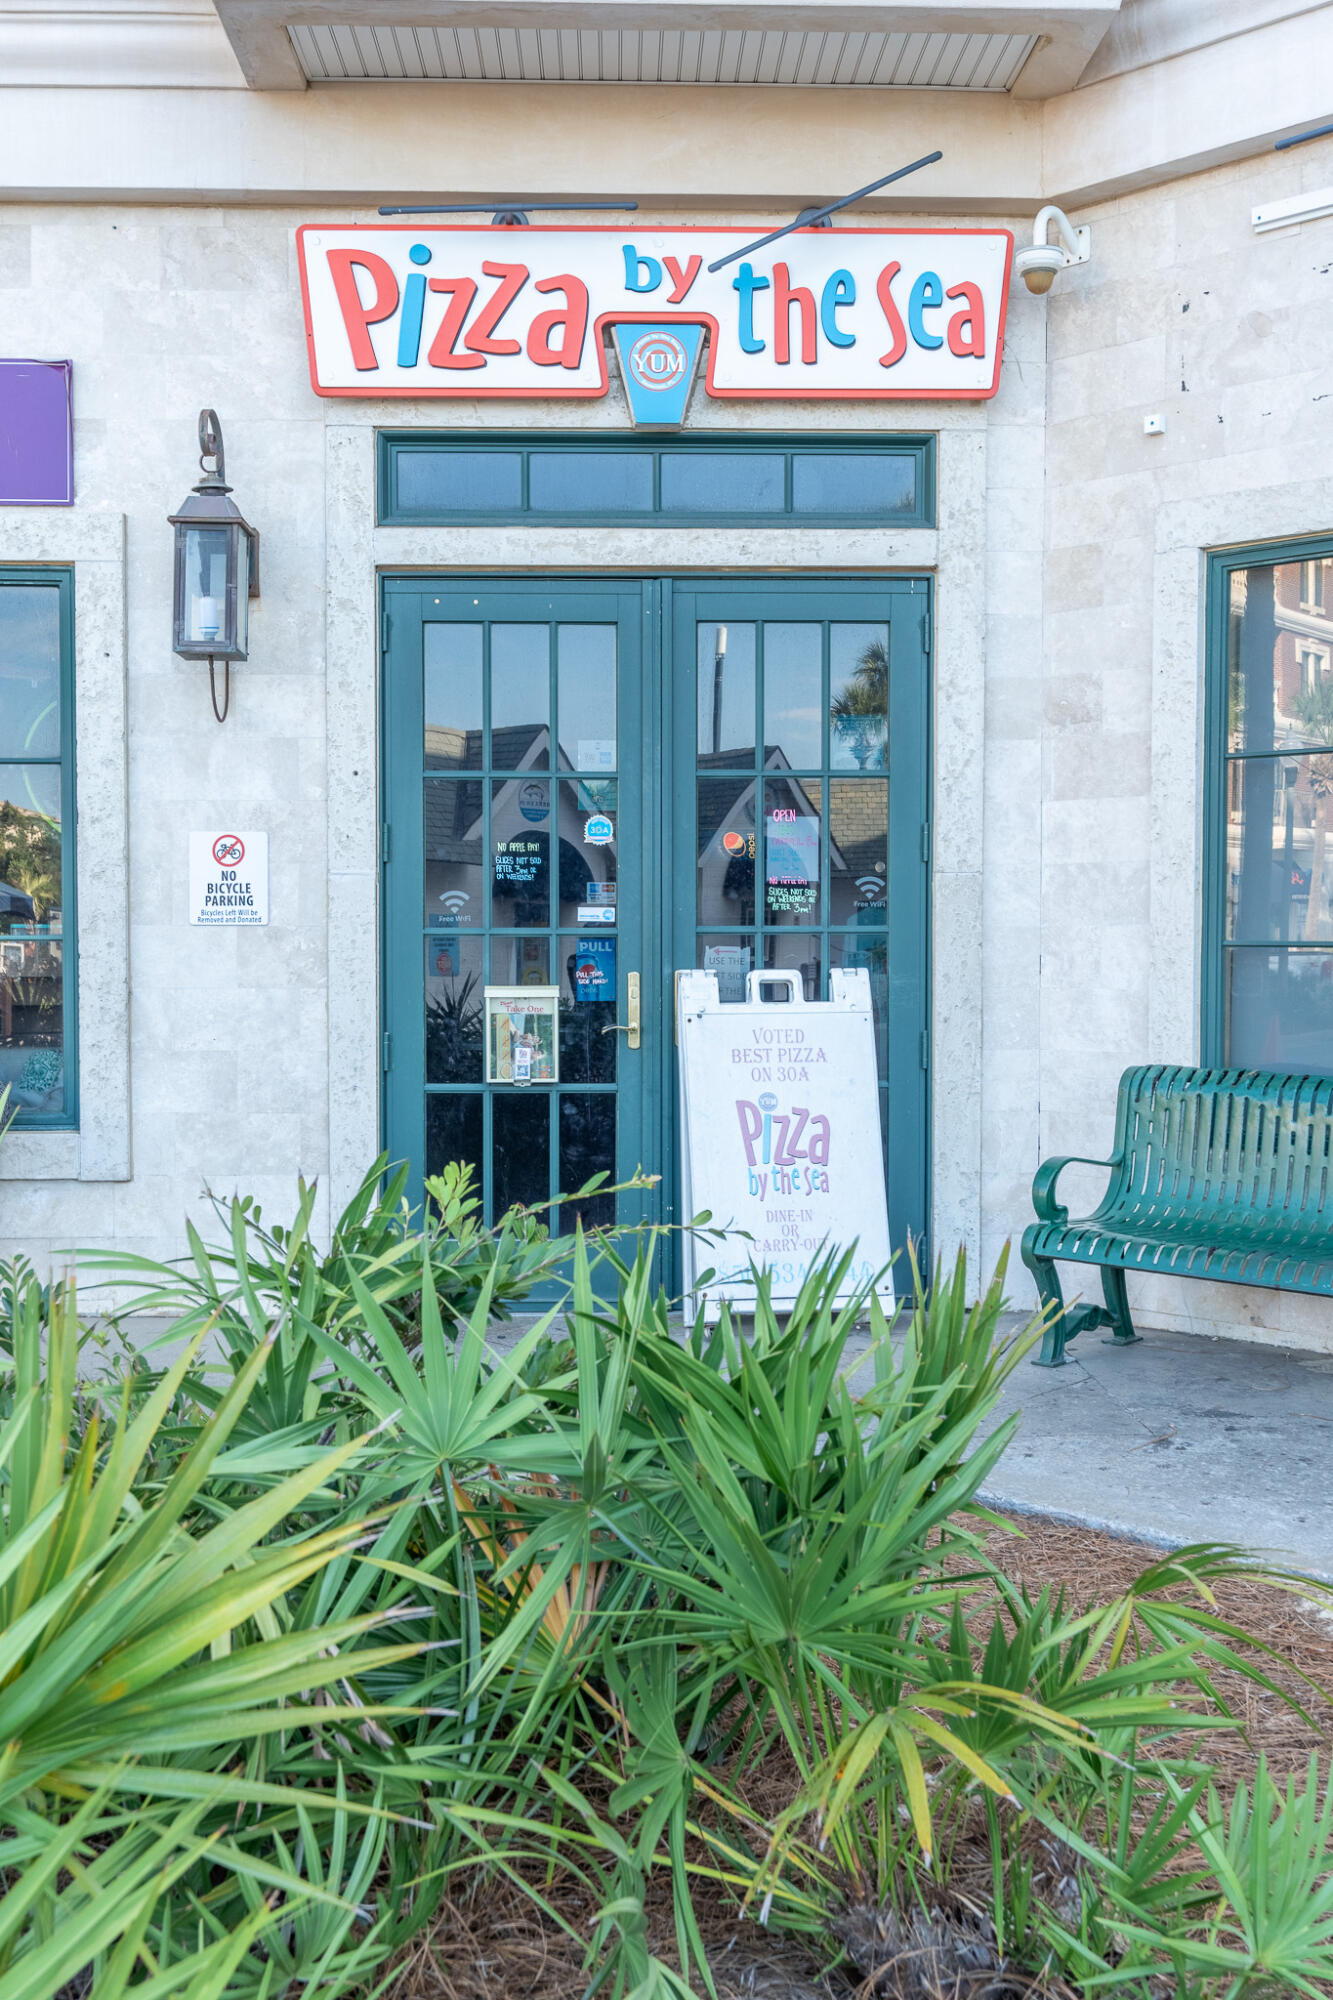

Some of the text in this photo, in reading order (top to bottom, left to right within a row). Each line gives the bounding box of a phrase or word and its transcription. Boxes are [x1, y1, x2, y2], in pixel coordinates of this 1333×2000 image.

[327, 244, 985, 371] Pizza by the Sea
[633, 352, 684, 373] YUM
[773, 809, 796, 823] OPEN
[498, 841, 507, 852] NO
[510, 842, 525, 852] APPLE
[221, 870, 237, 881] NO
[496, 865, 513, 873] AFTER
[207, 883, 251, 894] BICYCLE
[769, 886, 788, 896] SLICES
[804, 889, 817, 897] SOLD
[205, 895, 254, 906] PARKING
[201, 909, 224, 917] Bicycles
[580, 941, 613, 952] PULL
[709, 957, 745, 965] USE THE
[505, 1005, 544, 1013] Take One
[752, 1027, 805, 1044] VOTED
[731, 1047, 828, 1064] BEST PIZZA
[751, 1066, 810, 1082] ON 30A
[735, 1093, 830, 1166] Pizza
[748, 1166, 830, 1201] by the Sea
[766, 1209, 813, 1223] DINE-IN
[781, 1224, 799, 1240] OR
[754, 1238, 829, 1252] CARRY-OUT
